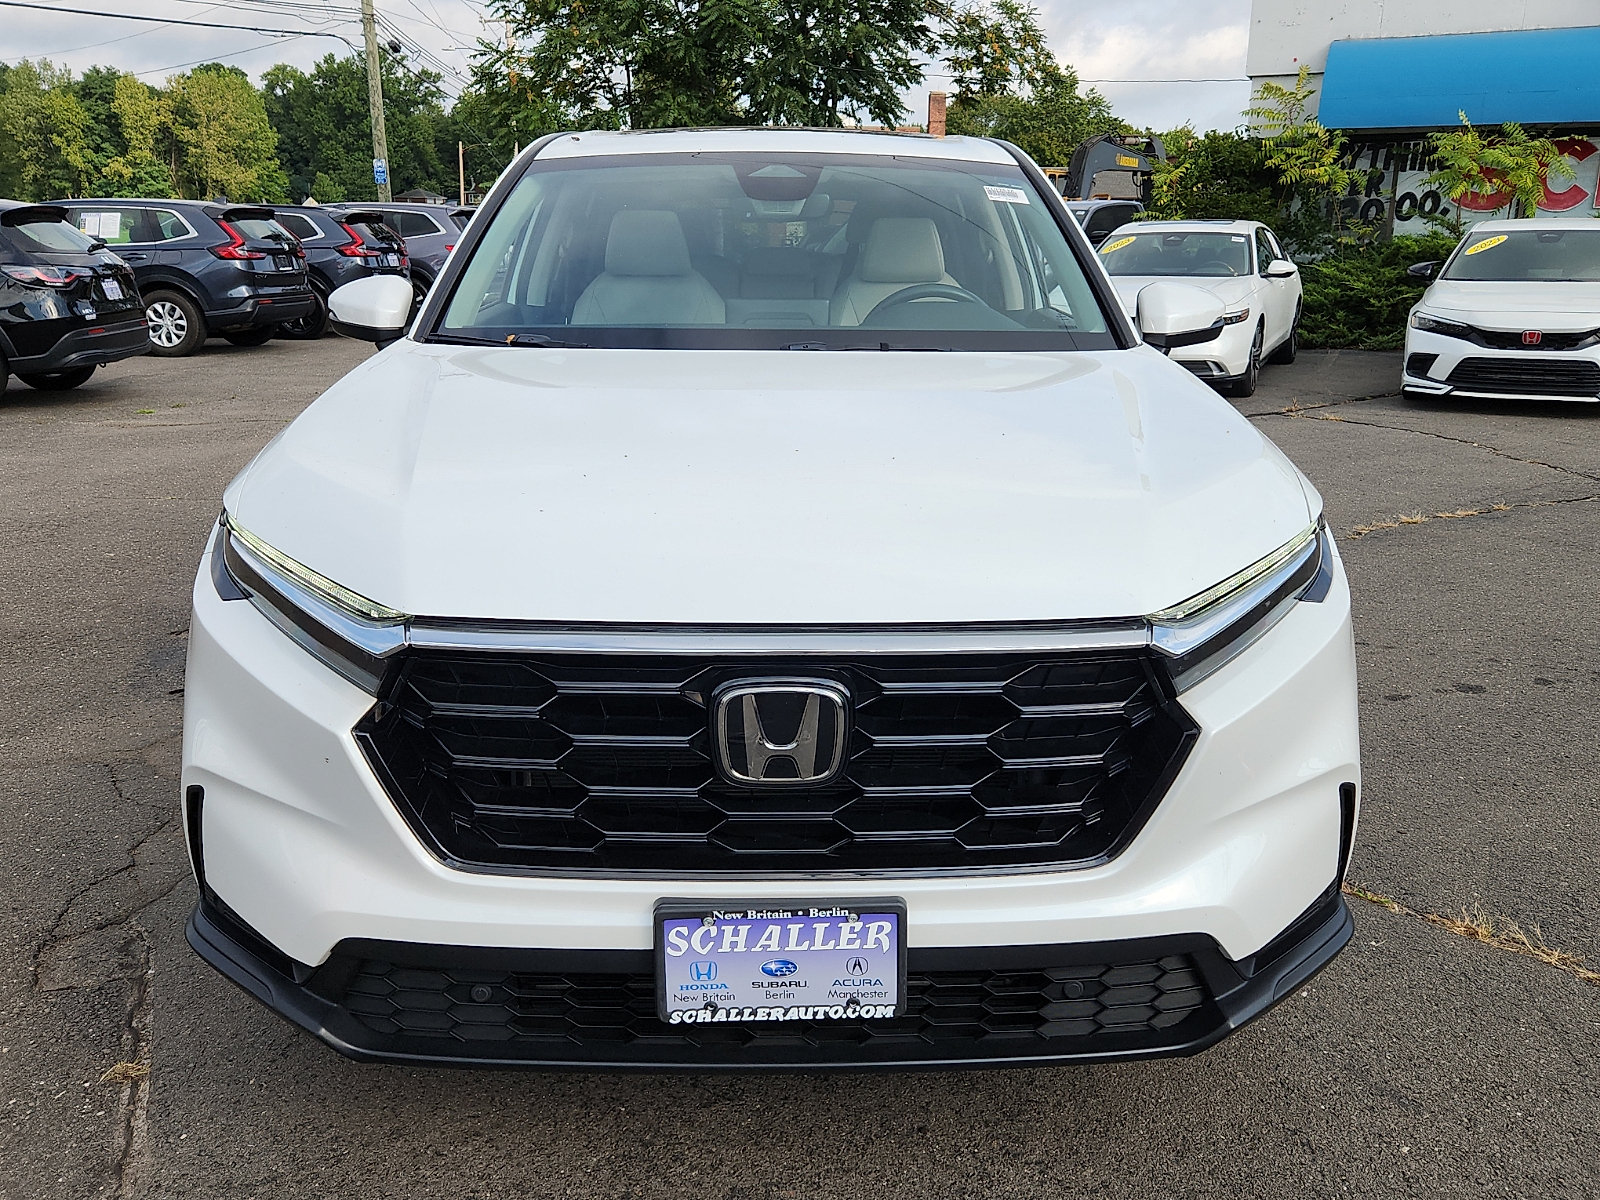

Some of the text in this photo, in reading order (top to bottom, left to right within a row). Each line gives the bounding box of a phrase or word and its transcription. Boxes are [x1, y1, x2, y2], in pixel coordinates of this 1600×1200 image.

[712, 907, 849, 920] New Britain Berlin
[666, 921, 892, 957] SCHALLER
[679, 983, 728, 991] HONDA
[751, 980, 807, 989] SUBARU
[832, 979, 884, 987] ACURA
[673, 992, 736, 1003] New Britain
[765, 989, 795, 1000] Berlin
[827, 989, 888, 999] Manchester
[669, 1005, 896, 1024] SCHALLERAUTO.COM
